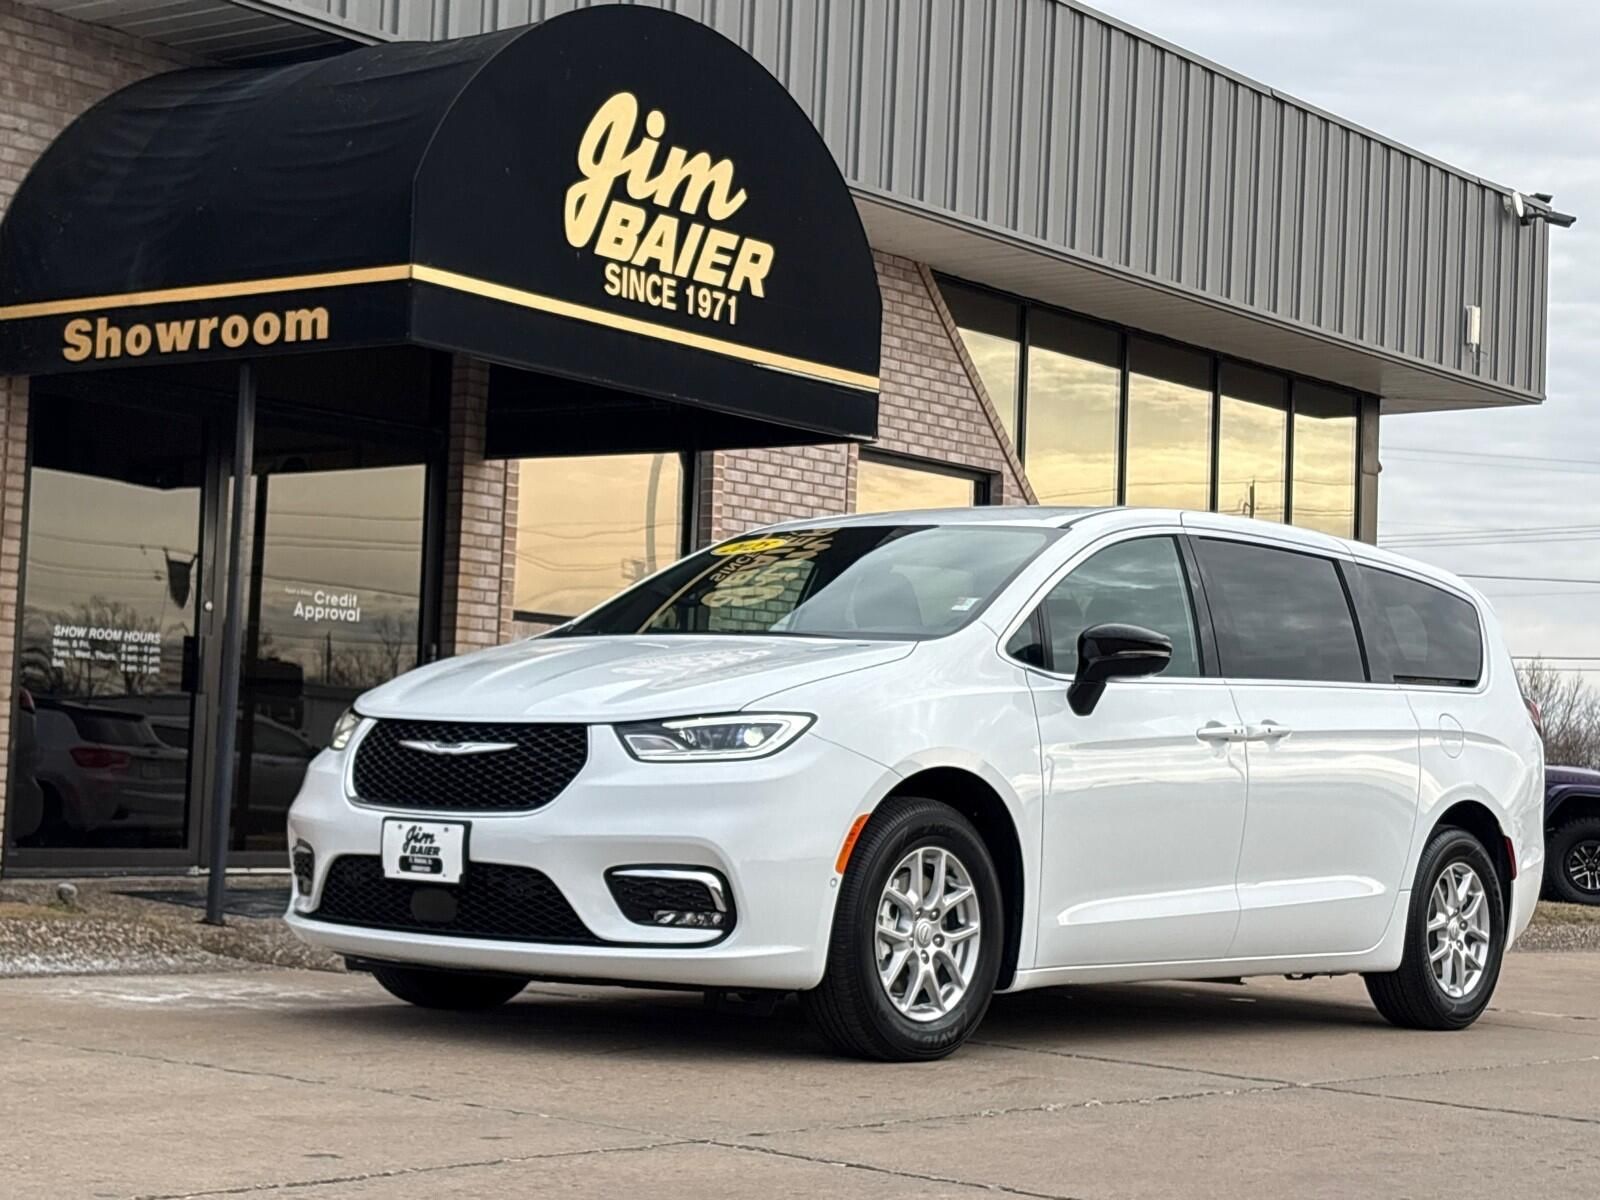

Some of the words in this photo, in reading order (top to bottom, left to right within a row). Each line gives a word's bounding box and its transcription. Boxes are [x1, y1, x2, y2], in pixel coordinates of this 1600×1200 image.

[565, 92, 747, 248] Jim
[594, 200, 775, 298] BAIER
[604, 262, 677, 311] SINCE
[685, 284, 737, 326] 1971
[62, 306, 329, 362] Showroom
[293, 600, 361, 622] Approval
[314, 590, 358, 608] Credit
[54, 624, 87, 638] SHOW
[89, 628, 122, 641] ROOM
[124, 631, 161, 645] HOURS
[402, 825, 436, 854] Jim
[410, 845, 441, 856] BAIER
